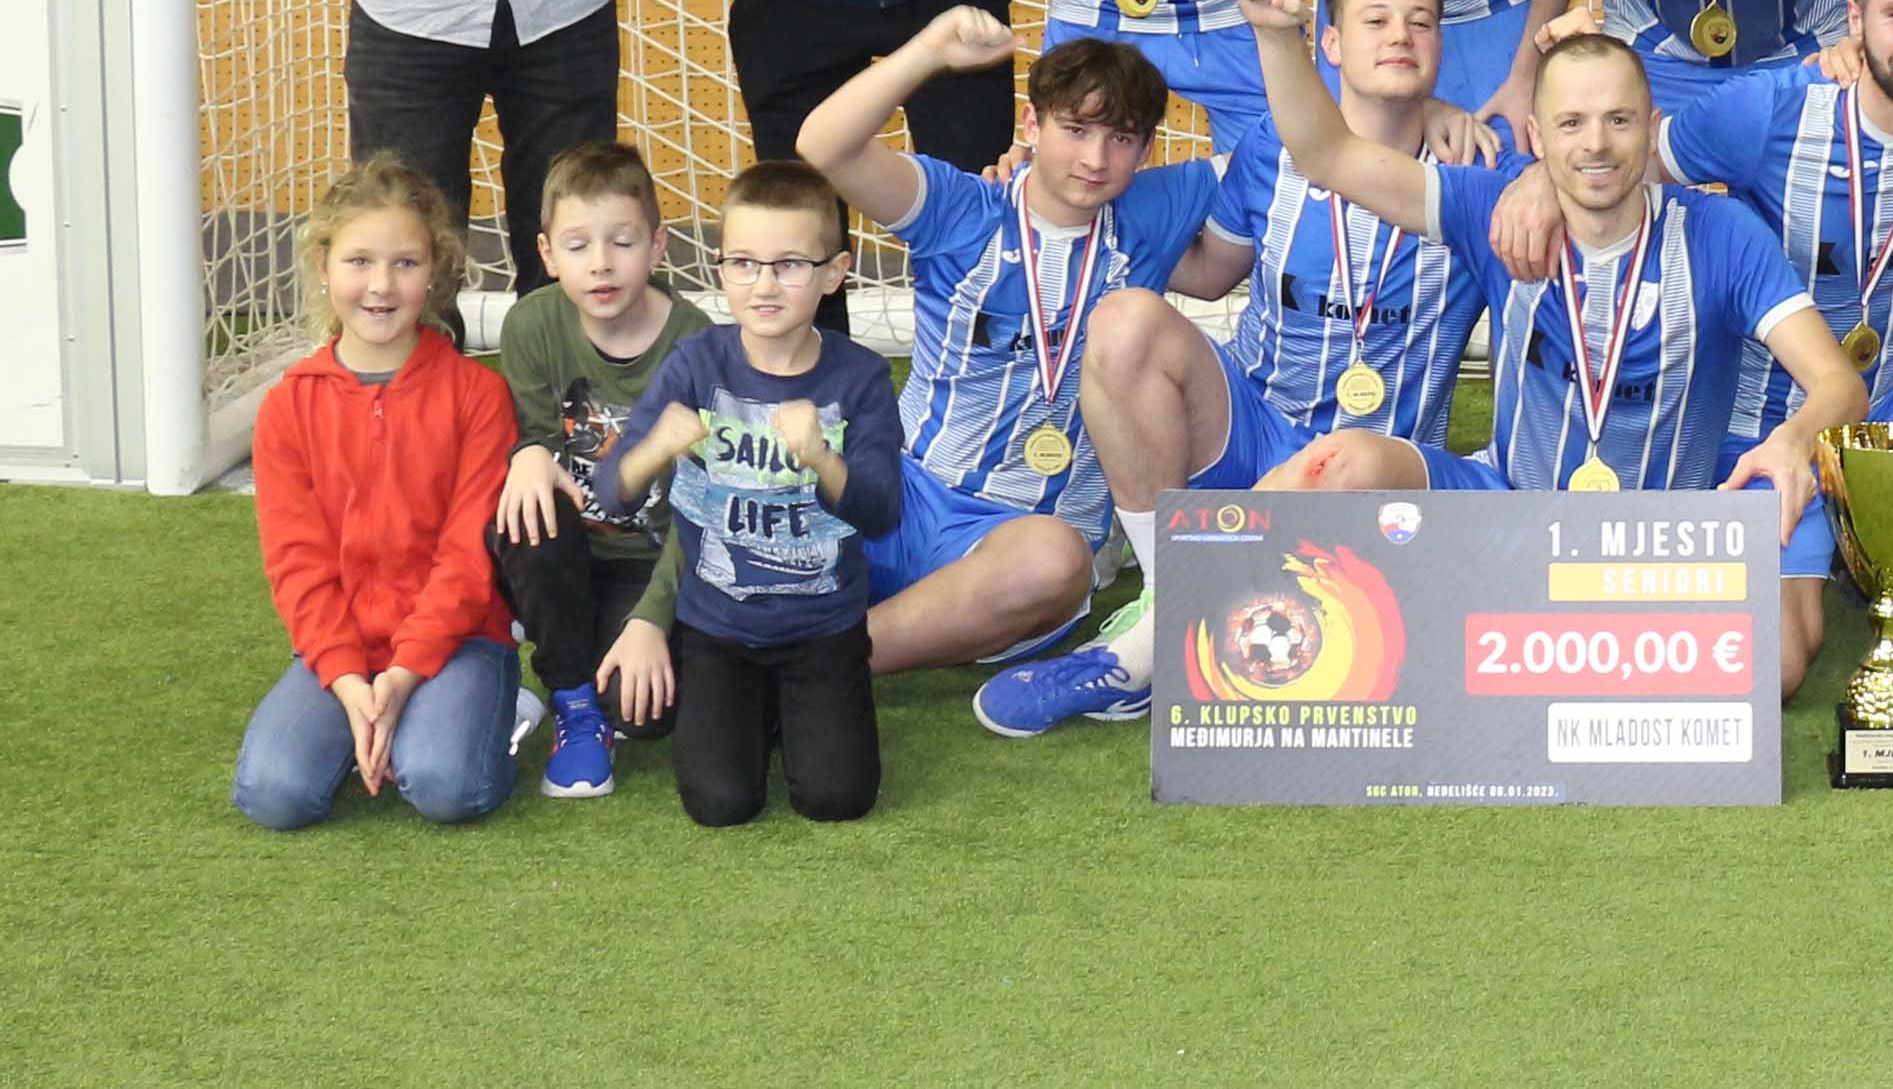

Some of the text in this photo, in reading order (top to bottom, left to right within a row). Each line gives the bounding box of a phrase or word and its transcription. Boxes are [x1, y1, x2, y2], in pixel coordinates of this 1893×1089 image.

[727, 495, 817, 539] LIFE
[1168, 504, 1272, 533] ATON
[1548, 520, 1745, 558] 1. MJESTO
[1602, 567, 1725, 595] SENIORI
[1476, 630, 1745, 680] 2.000,00 €
[1170, 705, 1417, 726] 6. KLUPSKO PRVENSTVO
[1170, 727, 1415, 749] MEĐIMURJA NA MANTINELE
[1556, 718, 1743, 748] NK MLADOST KOMET
